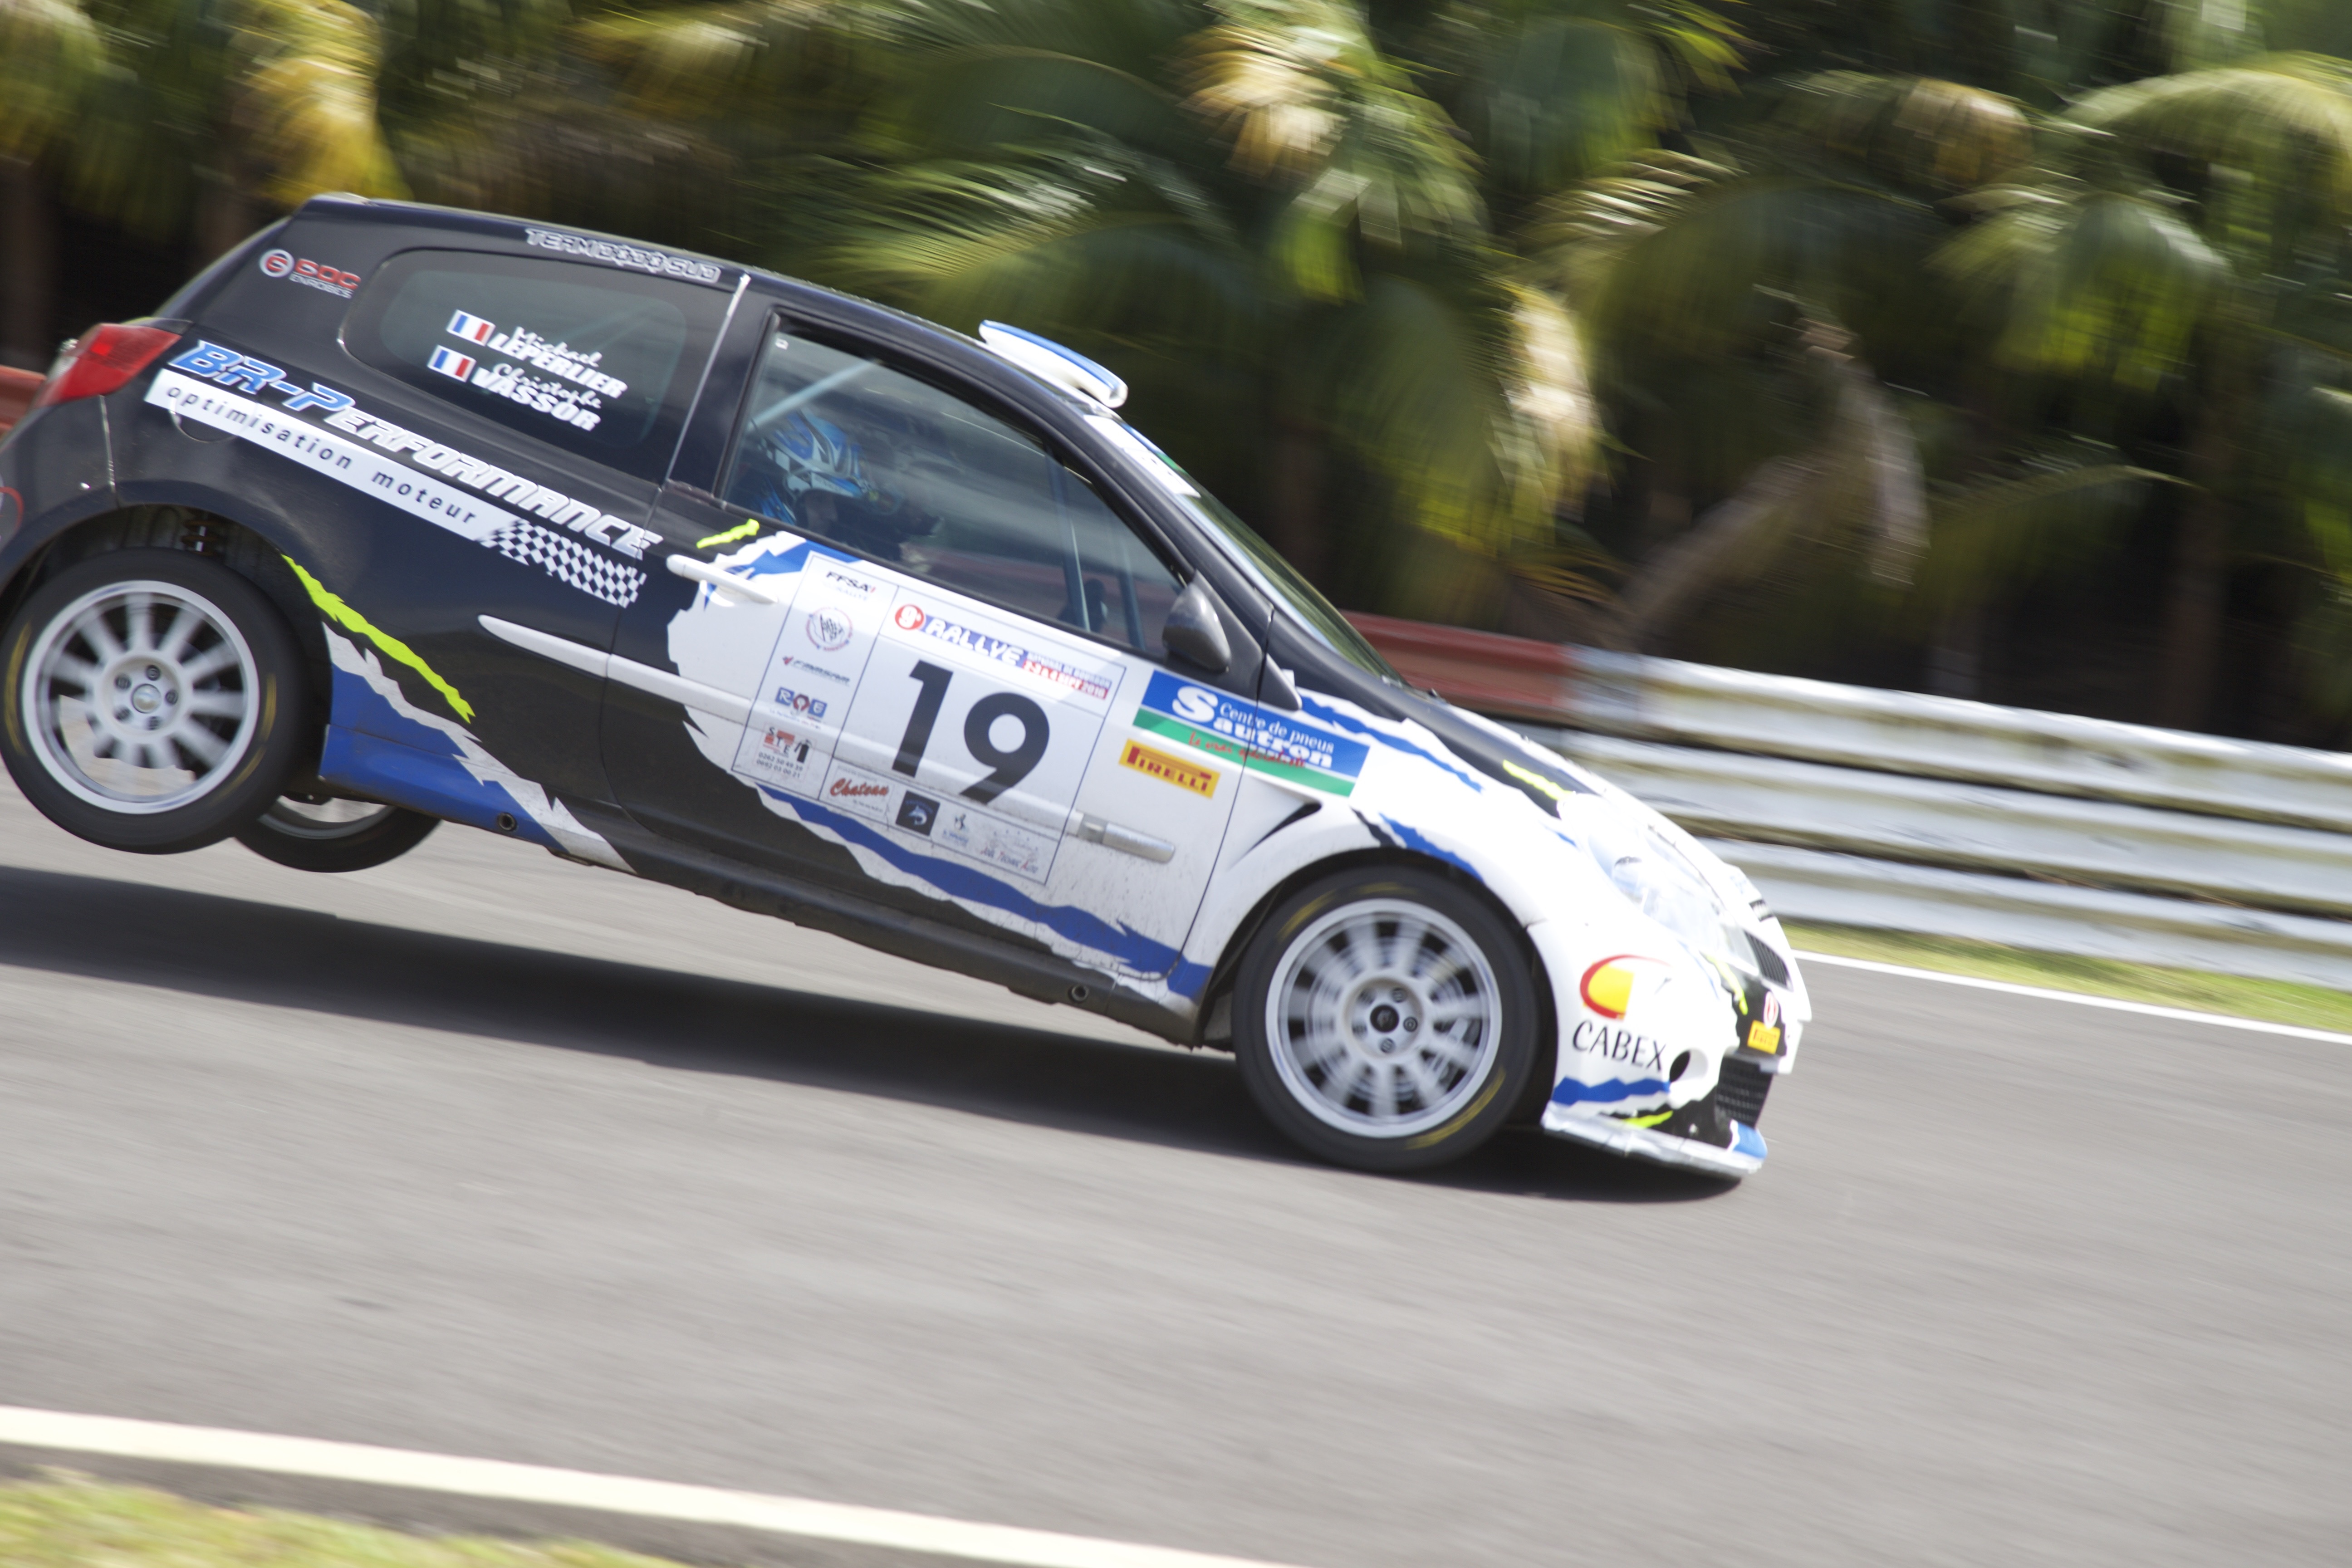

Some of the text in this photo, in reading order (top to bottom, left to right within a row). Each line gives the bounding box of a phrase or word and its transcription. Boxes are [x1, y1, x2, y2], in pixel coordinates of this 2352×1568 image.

[487, 333, 628, 399] LEPERLIER
[493, 363, 602, 409] Christophe
[471, 367, 601, 431] VASSOR
[167, 386, 478, 524] optimisation moteur
[826, 571, 868, 592] FFSA
[925, 617, 1024, 666] RALLYE
[892, 659, 1050, 805] 19
[1172, 686, 1333, 769] Sautron
[1220, 702, 1334, 754] Centre de pneus
[1127, 745, 1212, 793] PIRELLI
[1572, 1019, 1667, 1072] CABEX
